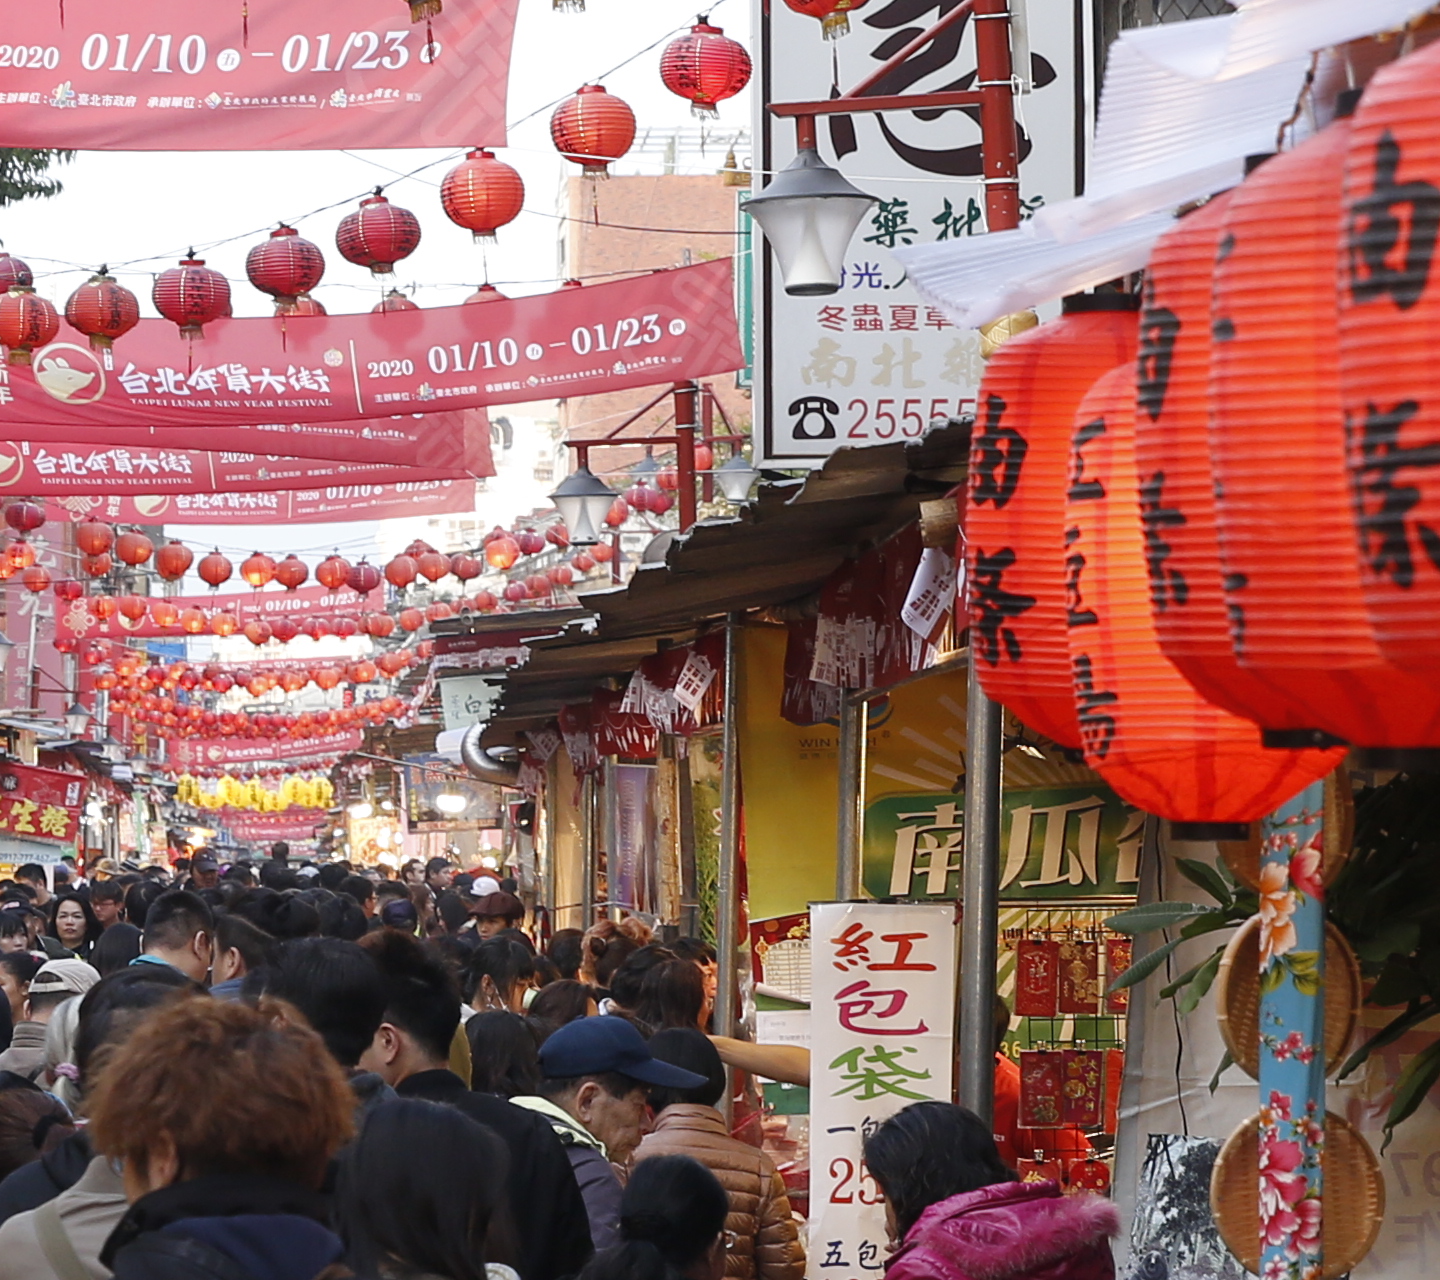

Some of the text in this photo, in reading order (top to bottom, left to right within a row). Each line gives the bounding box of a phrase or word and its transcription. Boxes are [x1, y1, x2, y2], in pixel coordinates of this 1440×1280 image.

[80, 31, 207, 75] 01/10
[280, 29, 410, 73] 01/23
[571, 313, 663, 355] 01/23
[117, 361, 332, 396] 台北年貨大街
[366, 336, 518, 379] 2020 01/10
[130, 397, 333, 409] TAIPEI LUNAR NEW YEAR FESTIVAL
[32, 446, 193, 477] 台北年貨大街
[829, 922, 937, 1101] 紅包袋
